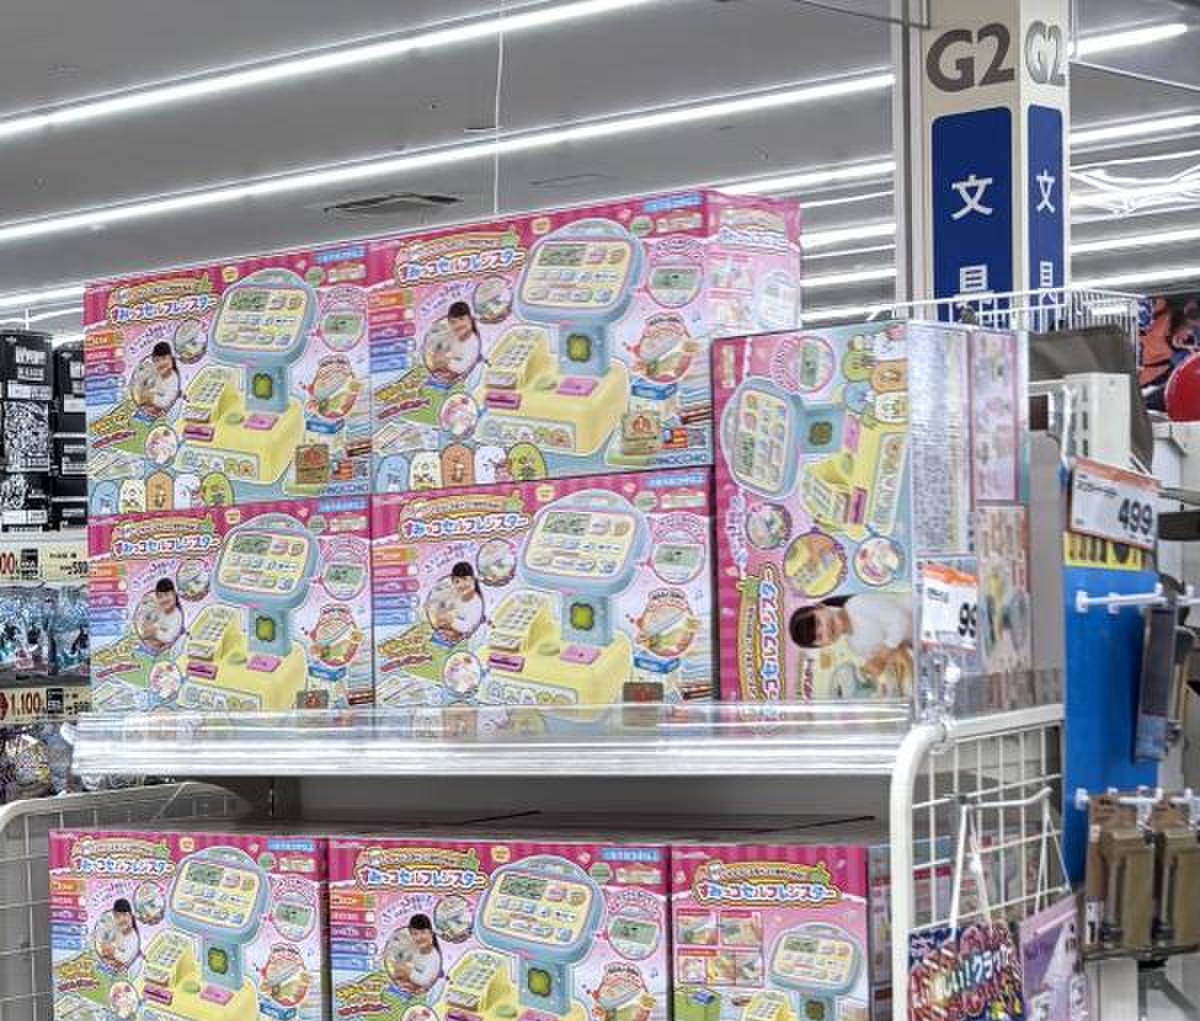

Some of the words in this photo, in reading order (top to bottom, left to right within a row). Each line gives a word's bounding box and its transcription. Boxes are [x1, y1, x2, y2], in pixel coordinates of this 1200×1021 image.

[926, 23, 1015, 93] G2
[1025, 20, 1066, 86] G2
[1118, 498, 1153, 535] 499
